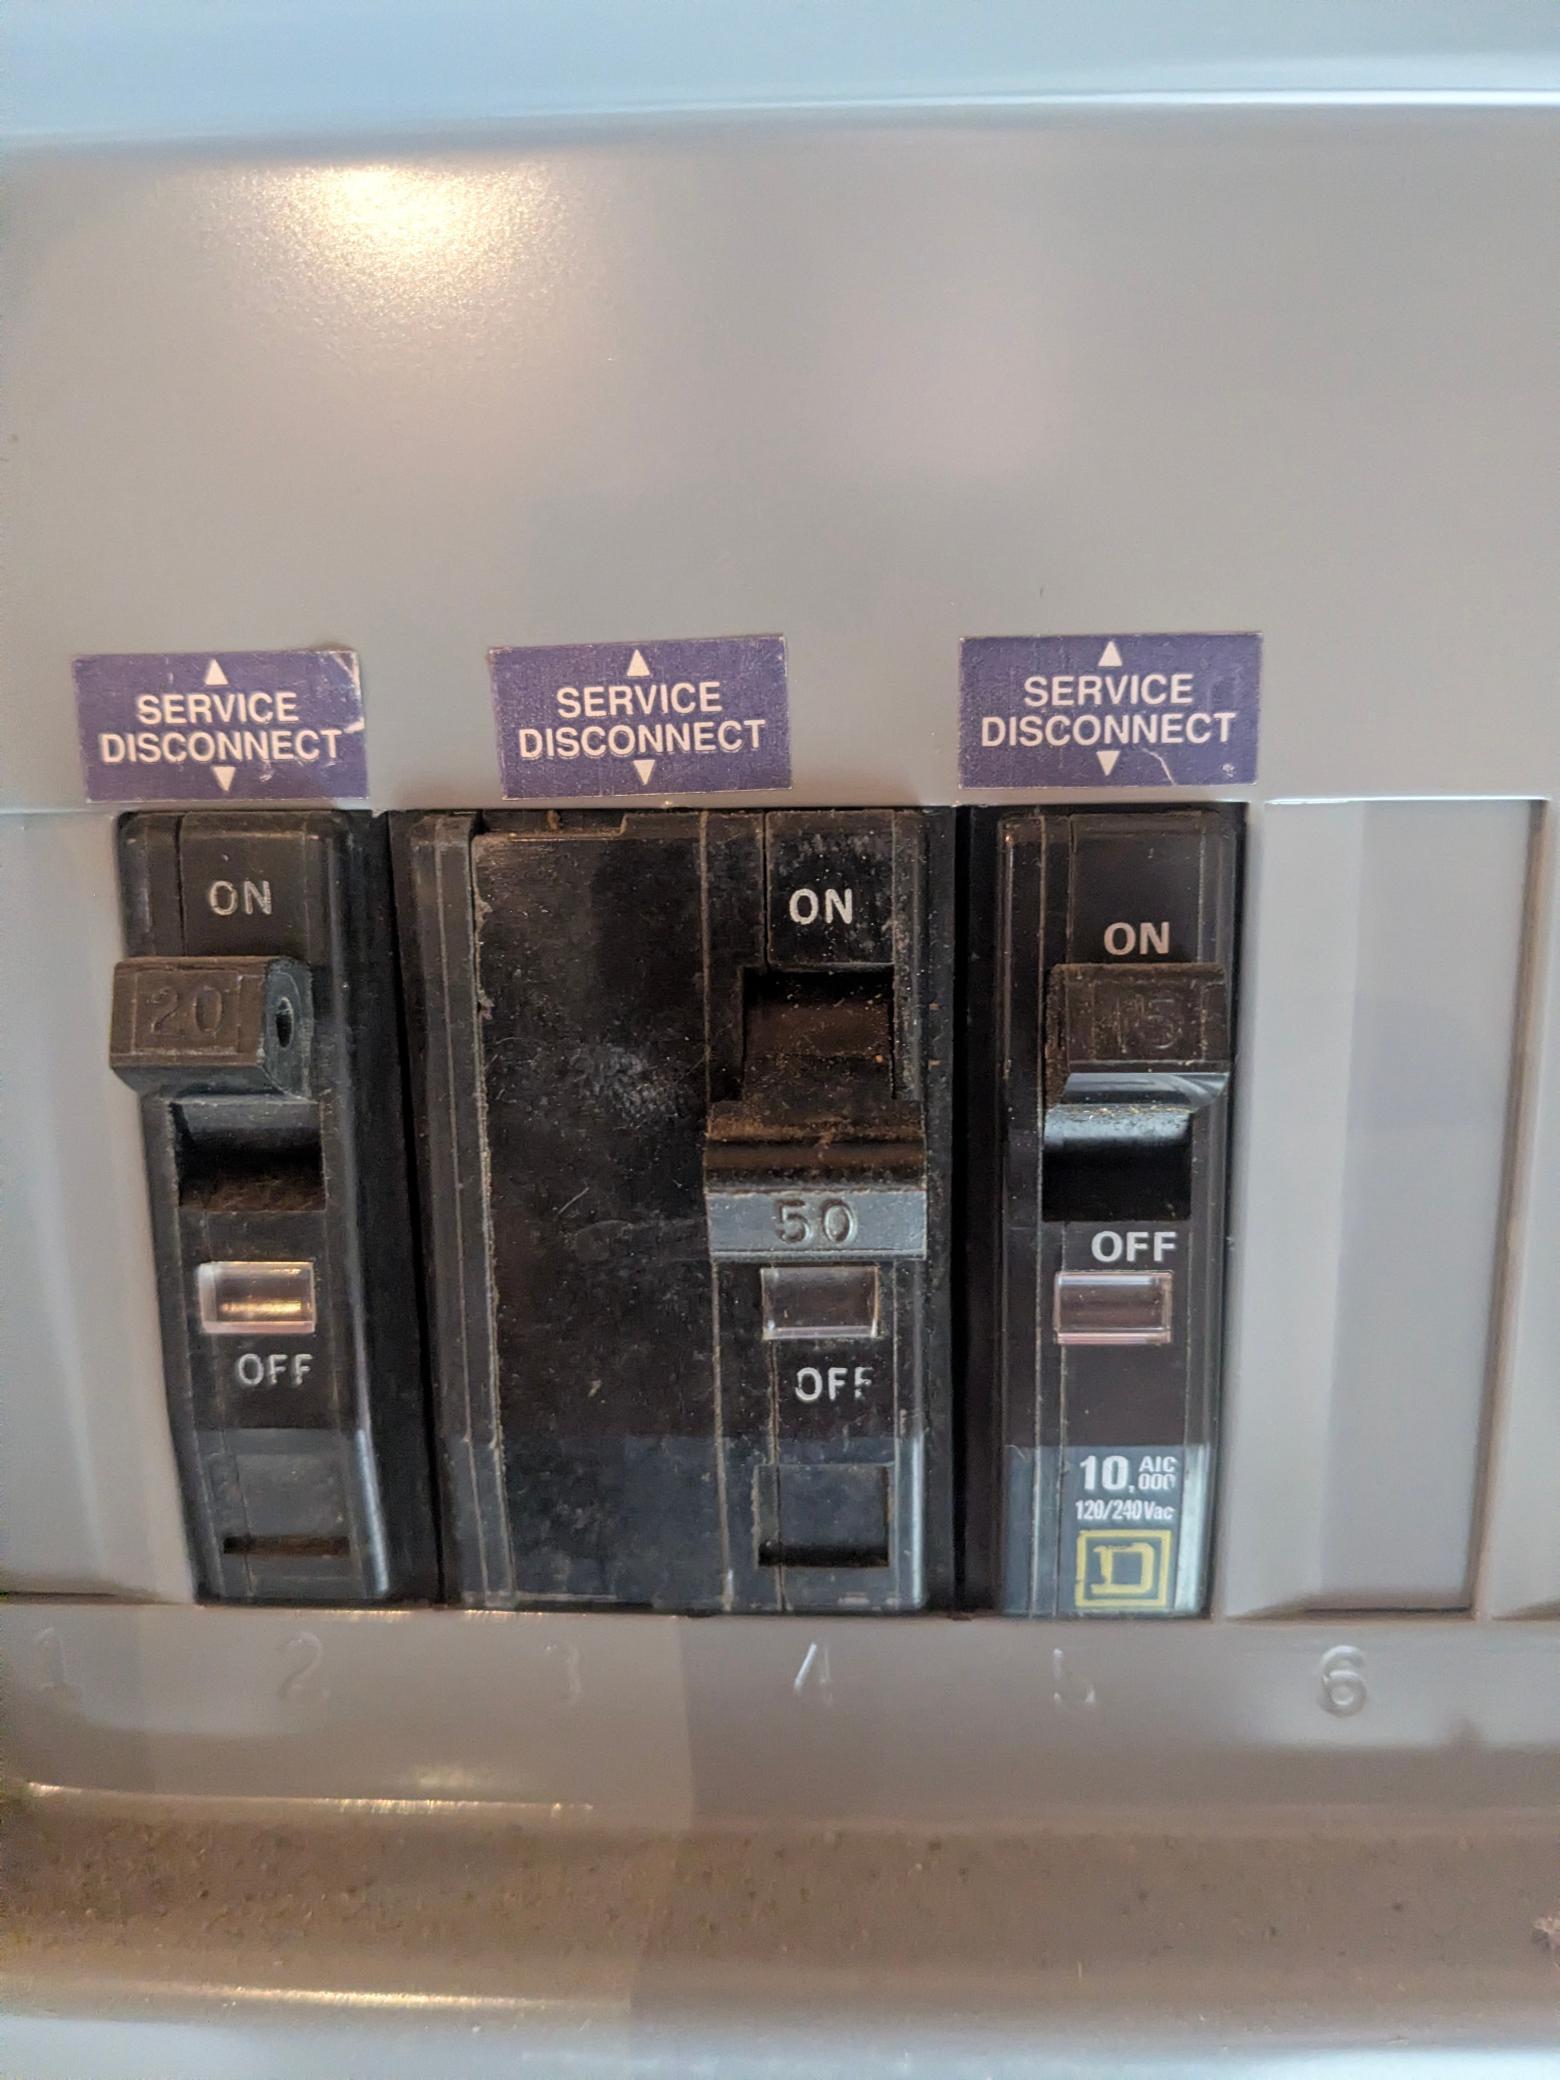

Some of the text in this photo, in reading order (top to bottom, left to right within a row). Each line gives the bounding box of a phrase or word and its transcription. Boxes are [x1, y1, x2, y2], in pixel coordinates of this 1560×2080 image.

[556, 681, 722, 719] SERVICE
[1023, 673, 1193, 707] SERVICE
[136, 691, 299, 726] SERVICE
[100, 729, 342, 764] DISCONNECT
[518, 719, 766, 760] DISCONNECT
[981, 712, 1237, 748] DISCONNECT
[209, 880, 272, 916] ON
[789, 888, 854, 926] ON
[1103, 921, 1170, 956] ON
[146, 985, 225, 1042] 20
[774, 1199, 857, 1245] 50
[1091, 1230, 1177, 1263] OFF
[235, 1352, 314, 1387] OFF
[794, 1366, 874, 1402] OFF
[1138, 1456, 1178, 1472] AIC
[275, 1630, 330, 1699] 2
[1317, 1644, 1368, 1716] 6
